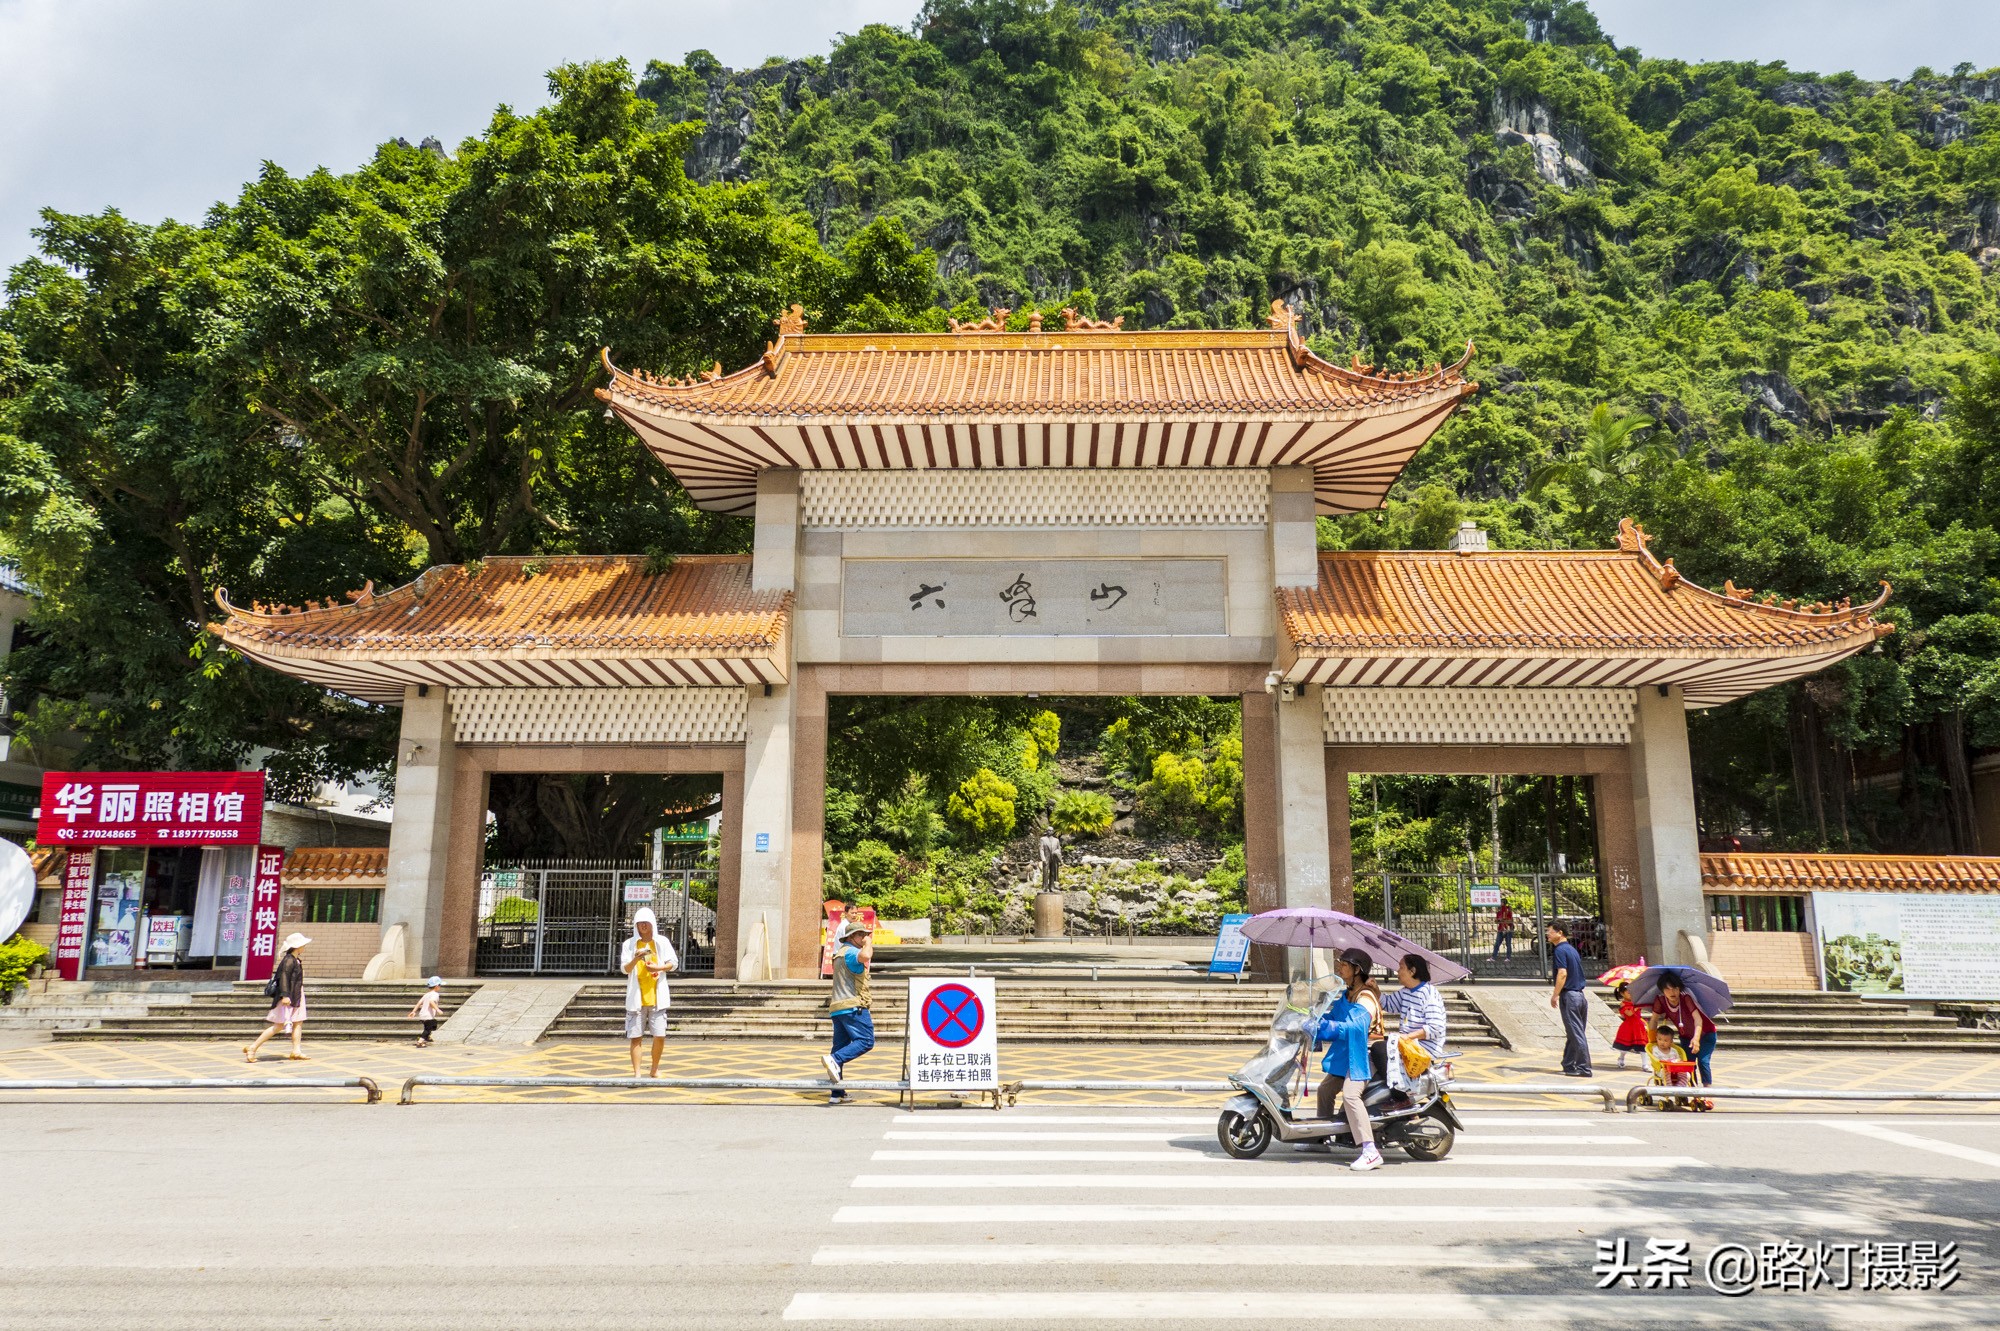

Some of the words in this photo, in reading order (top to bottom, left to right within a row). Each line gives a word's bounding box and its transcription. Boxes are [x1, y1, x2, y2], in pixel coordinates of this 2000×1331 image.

[53, 783, 245, 823] 华丽照相馆
[82, 830, 137, 839] 270248665
[172, 830, 239, 839] 18977750558
[70, 853, 92, 865] 扫描
[69, 867, 90, 878] 复印
[252, 853, 281, 956] 证件快相
[152, 920, 175, 932] 饮料
[918, 1053, 991, 1066] 此车位已取消
[918, 1069, 992, 1082] 违停拖车拍照
